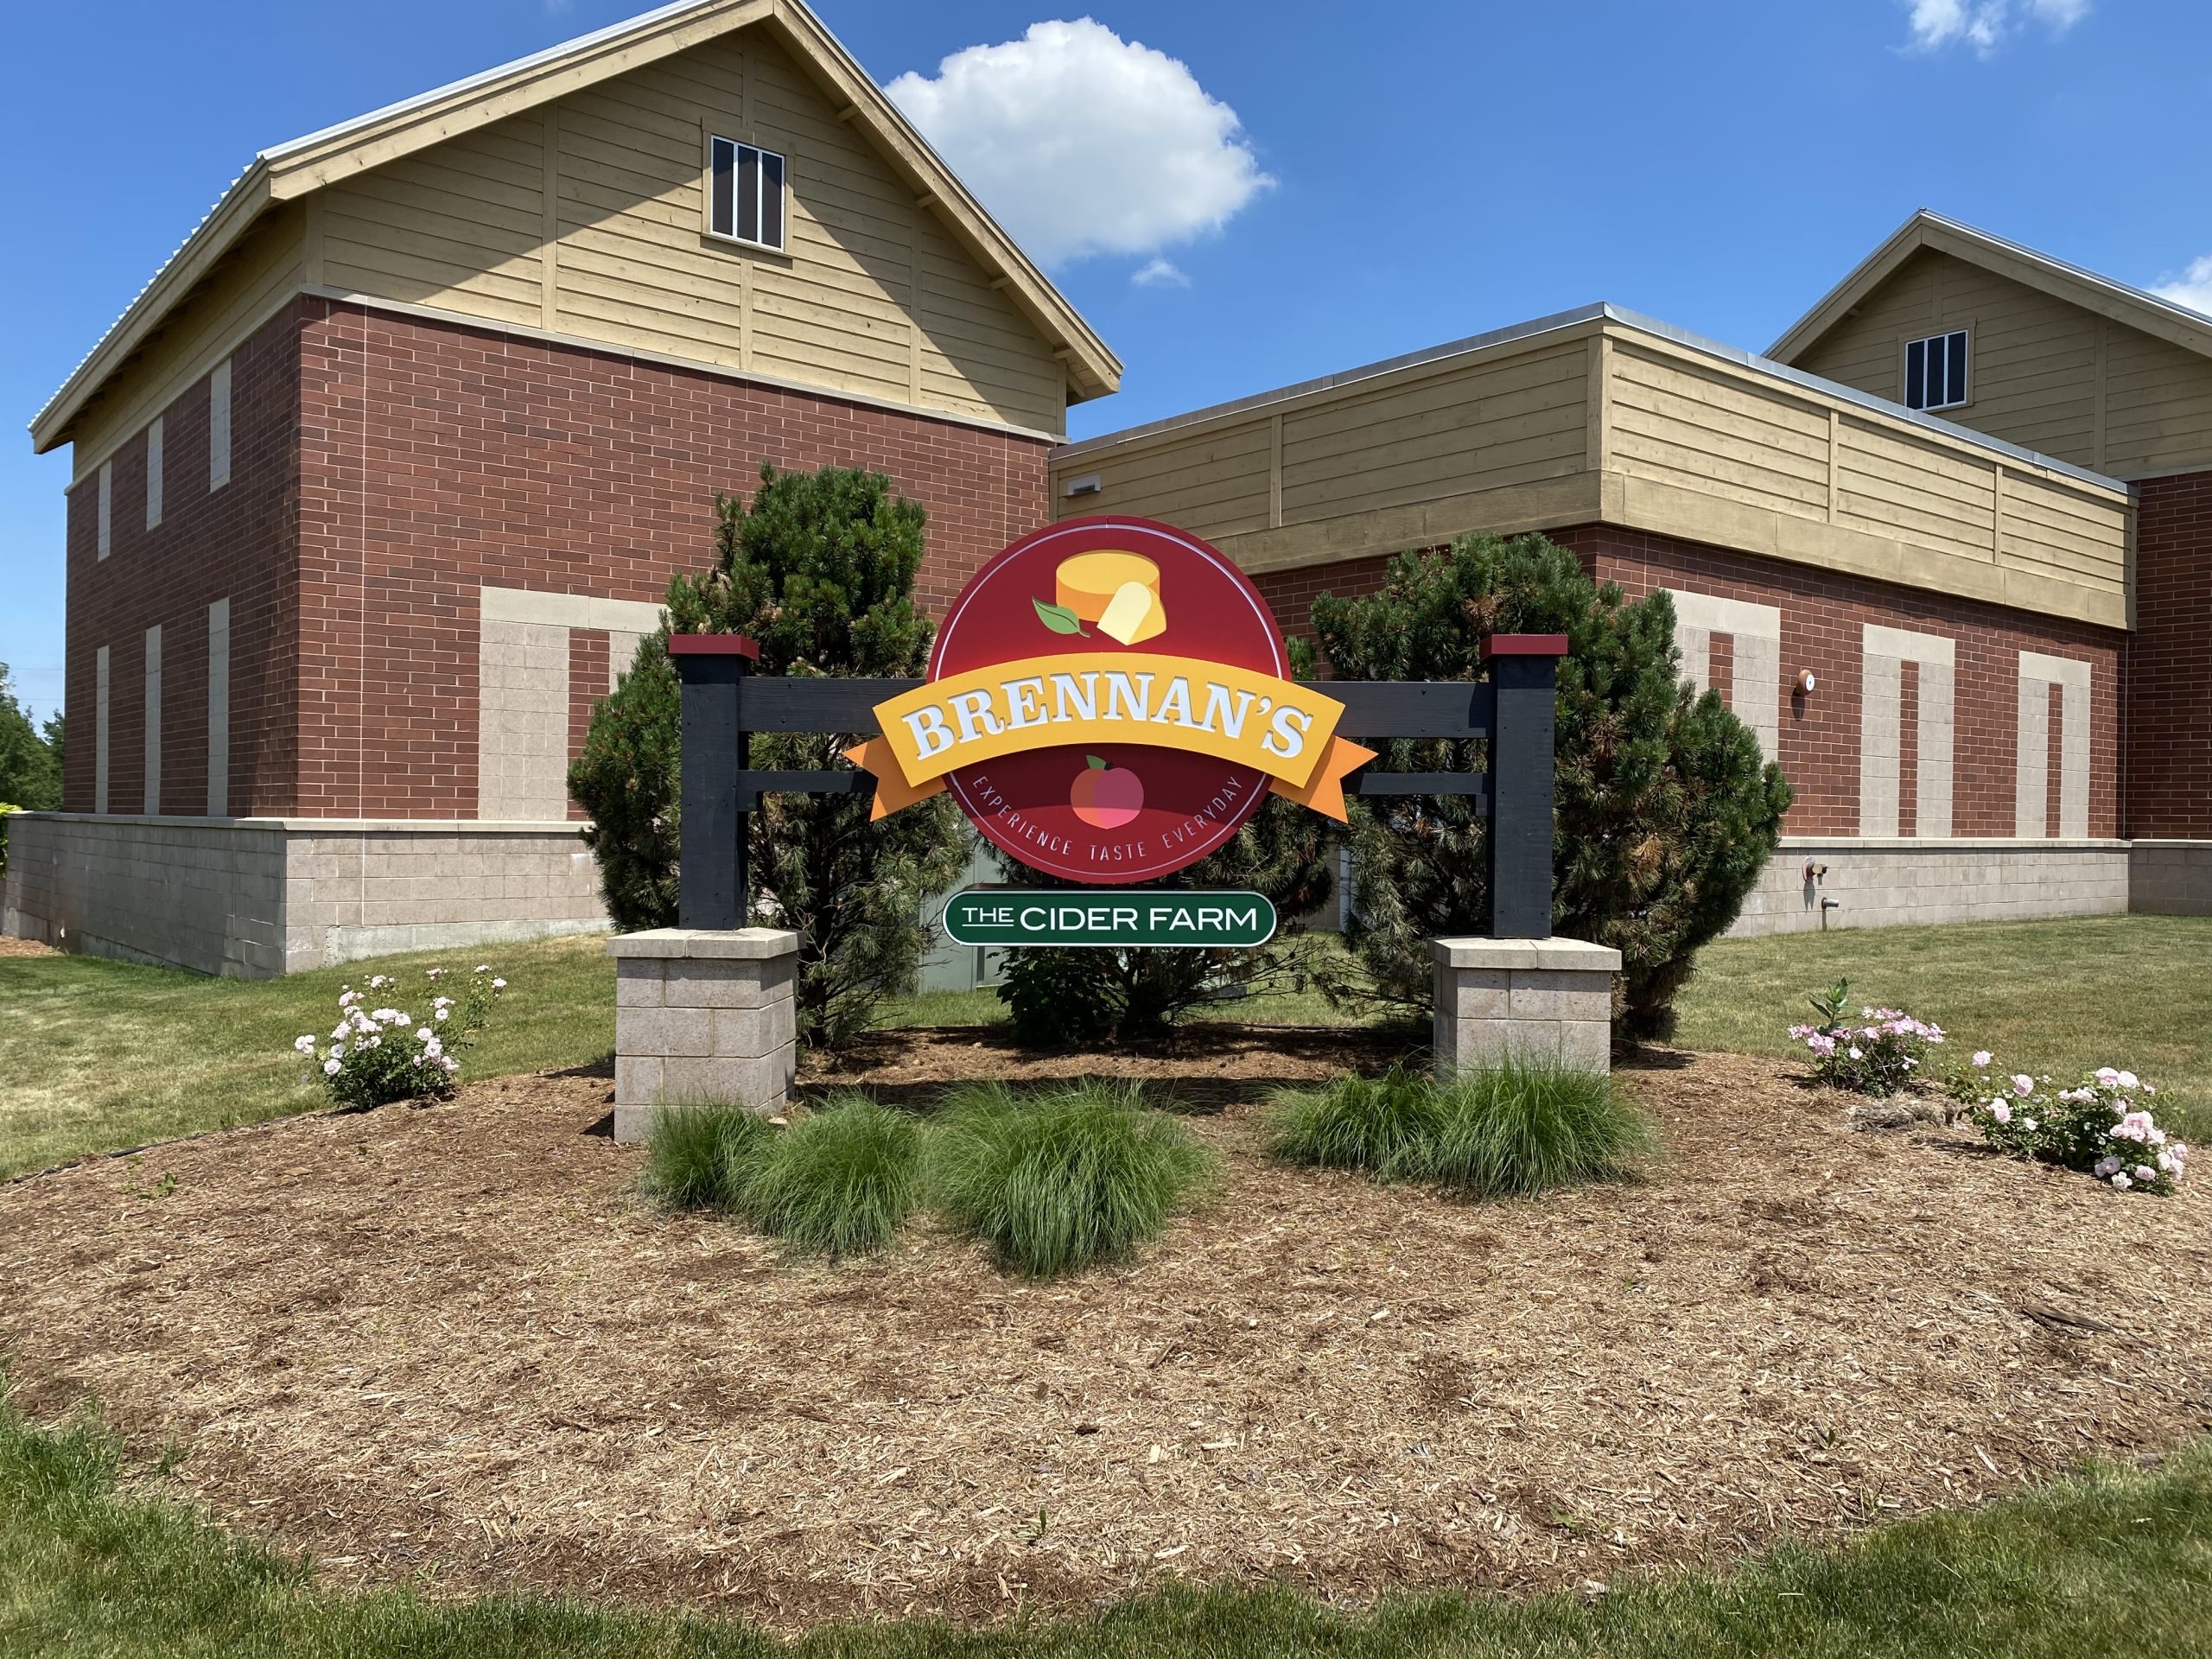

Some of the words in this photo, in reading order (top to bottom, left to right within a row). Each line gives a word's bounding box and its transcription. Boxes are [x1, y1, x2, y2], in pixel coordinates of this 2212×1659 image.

[902, 671, 1313, 760] BRENNAN'S
[973, 776, 1072, 855] EXPERIENCE
[1090, 842, 1147, 861] TASTE
[1162, 776, 1242, 849] EVERYDAY
[962, 907, 1014, 922] THE
[1020, 907, 1137, 931] CIDER
[1149, 907, 1257, 931] FARM
